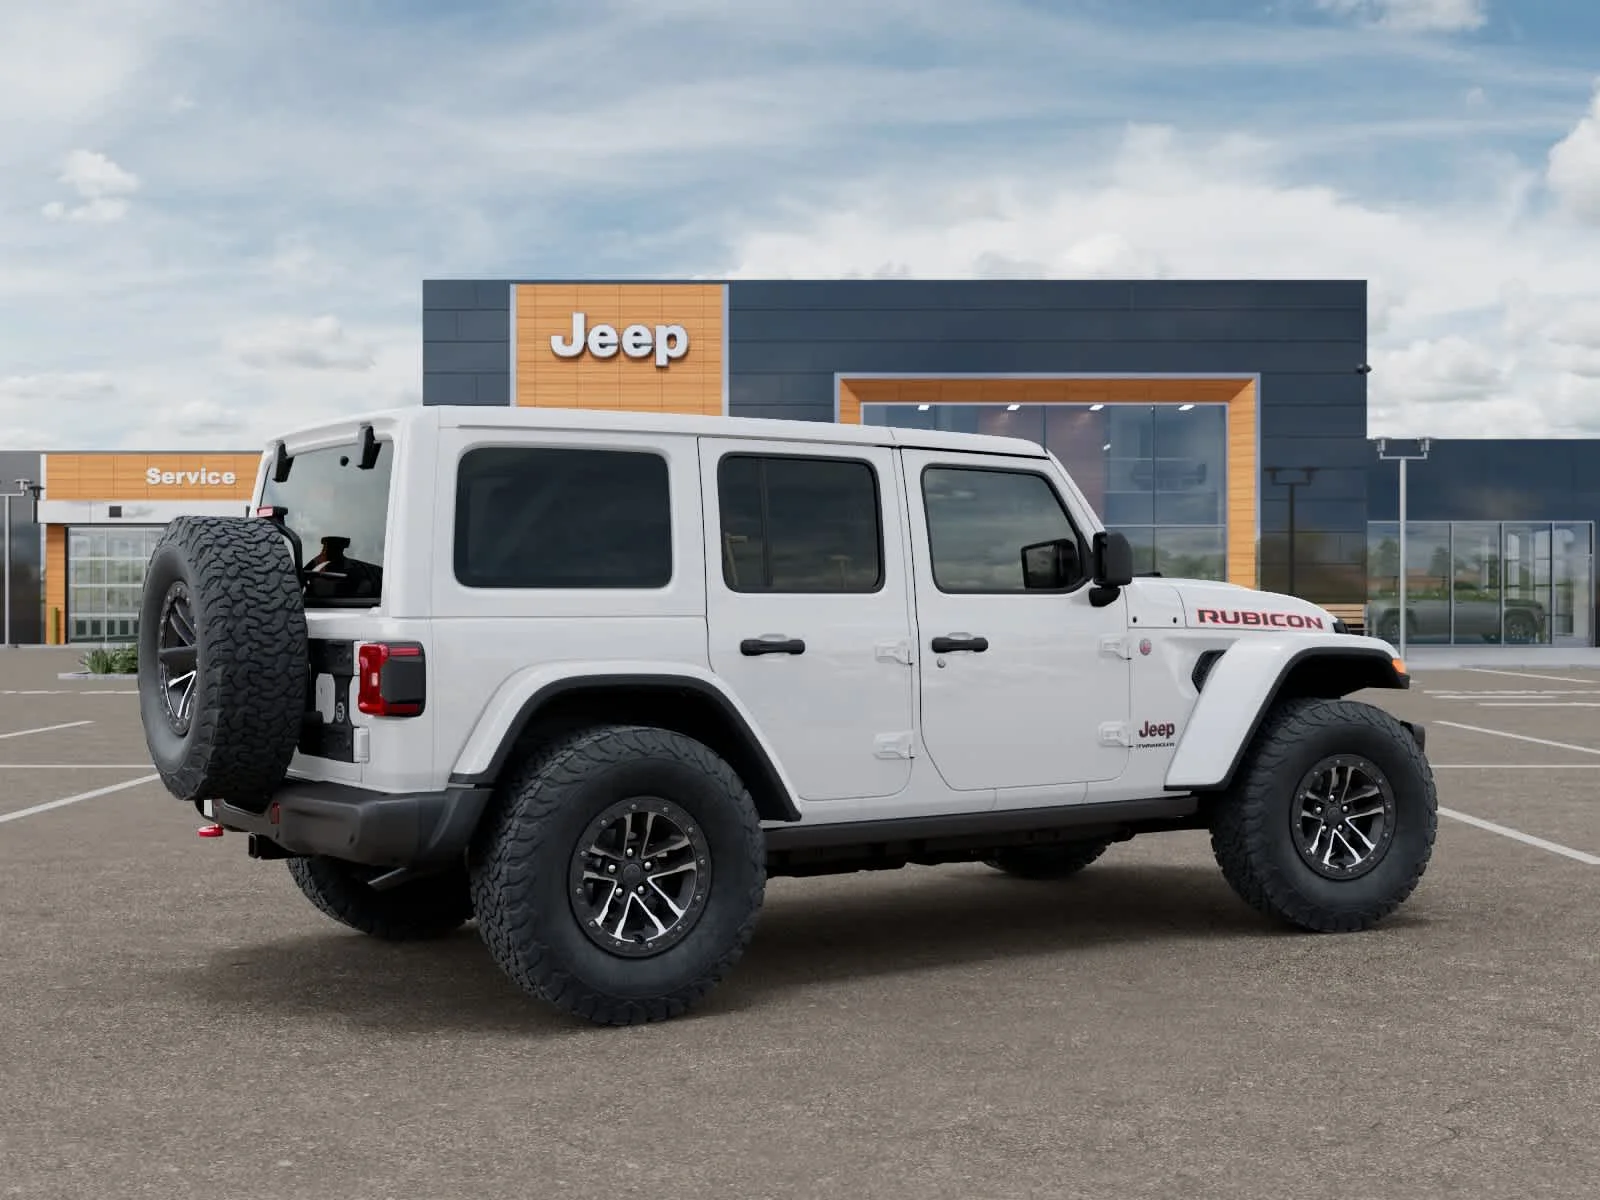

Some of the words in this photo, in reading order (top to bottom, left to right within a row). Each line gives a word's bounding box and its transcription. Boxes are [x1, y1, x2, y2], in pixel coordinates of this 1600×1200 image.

[550, 311, 689, 368] Jeep
[145, 467, 237, 486] Service
[1197, 608, 1324, 630] RUBICON
[1138, 720, 1175, 739] Jeep
